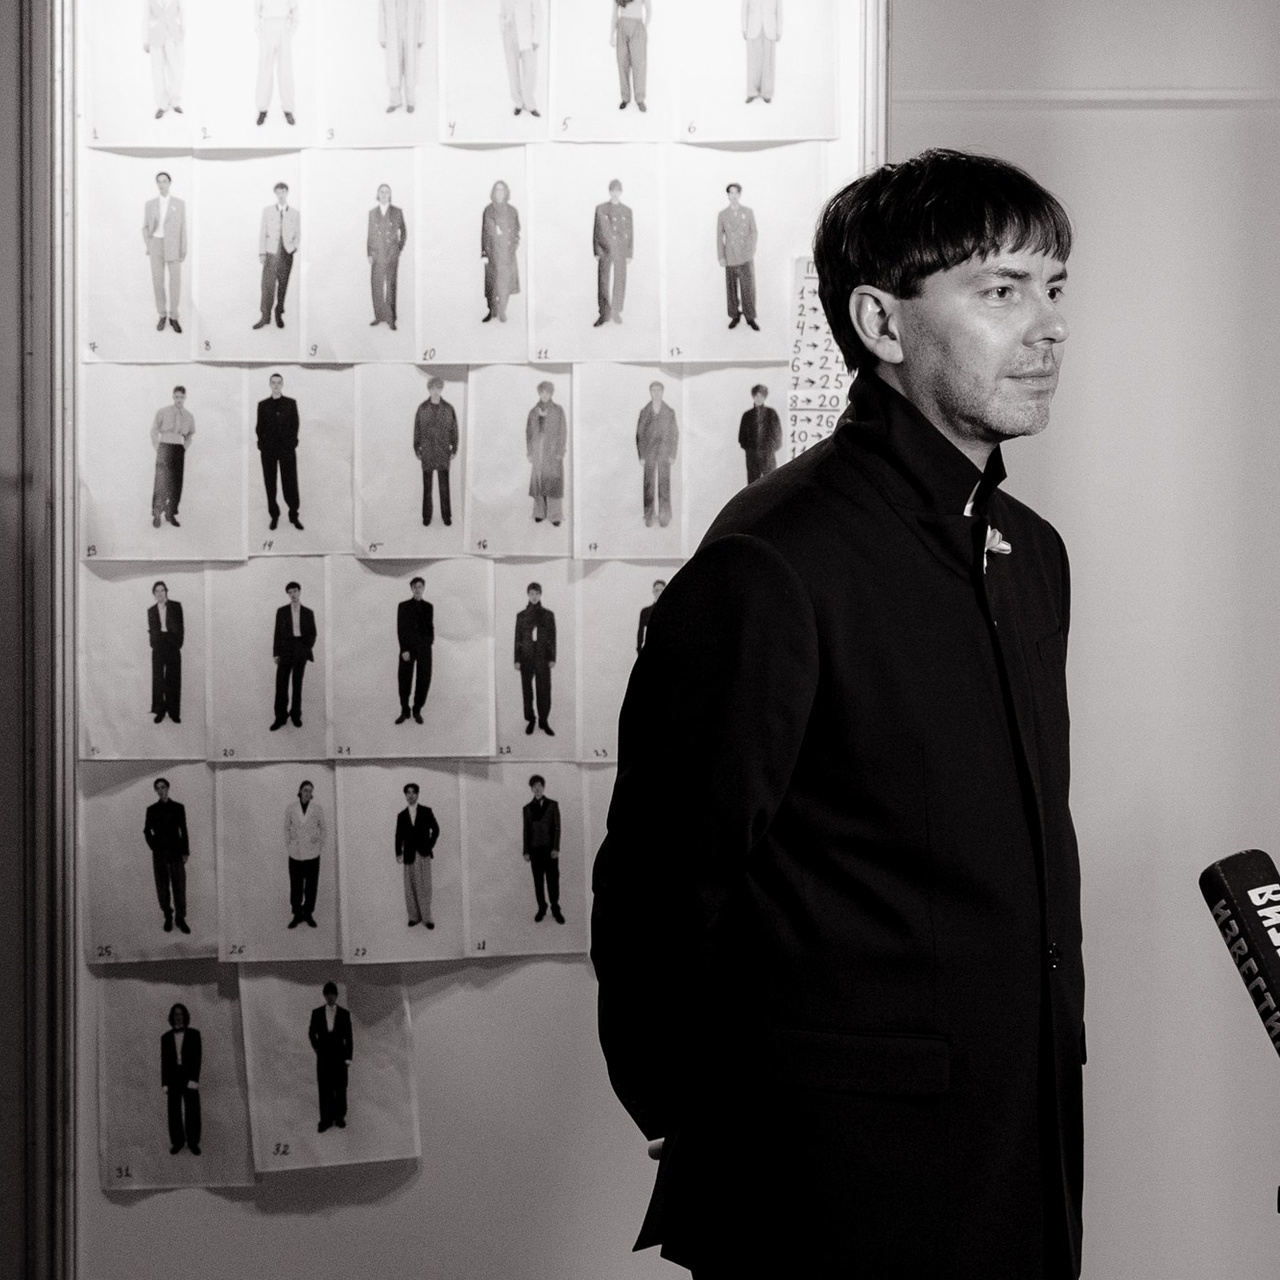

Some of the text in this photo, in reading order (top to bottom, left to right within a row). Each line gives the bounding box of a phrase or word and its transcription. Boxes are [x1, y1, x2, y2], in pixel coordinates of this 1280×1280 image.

[448, 122, 456, 136] 4
[562, 117, 571, 131] 5
[687, 121, 697, 134] 6
[93, 128, 99, 140] 1
[202, 127, 211, 140] 2
[327, 128, 335, 140] 3
[799, 287, 805, 300] 1
[798, 304, 806, 316] 2
[796, 321, 805, 336] 4
[204, 340, 211, 351] 8
[309, 344, 318, 356] 9
[793, 339, 802, 354] 5
[423, 348, 436, 361] 10
[537, 349, 548, 359] 11
[791, 355, 845, 373] 6 24
[793, 373, 847, 390] 7 25
[790, 395, 799, 409] 8
[818, 394, 840, 408] 20
[790, 414, 836, 429] 9 26
[790, 430, 808, 443] 10
[223, 749, 235, 757] 20
[97, 945, 112, 957] 25
[229, 945, 246, 955] 26
[1212, 898, 1280, 1054] ИЗВЕСТИ
[273, 1143, 289, 1156] 32
[116, 1166, 132, 1179] 31
